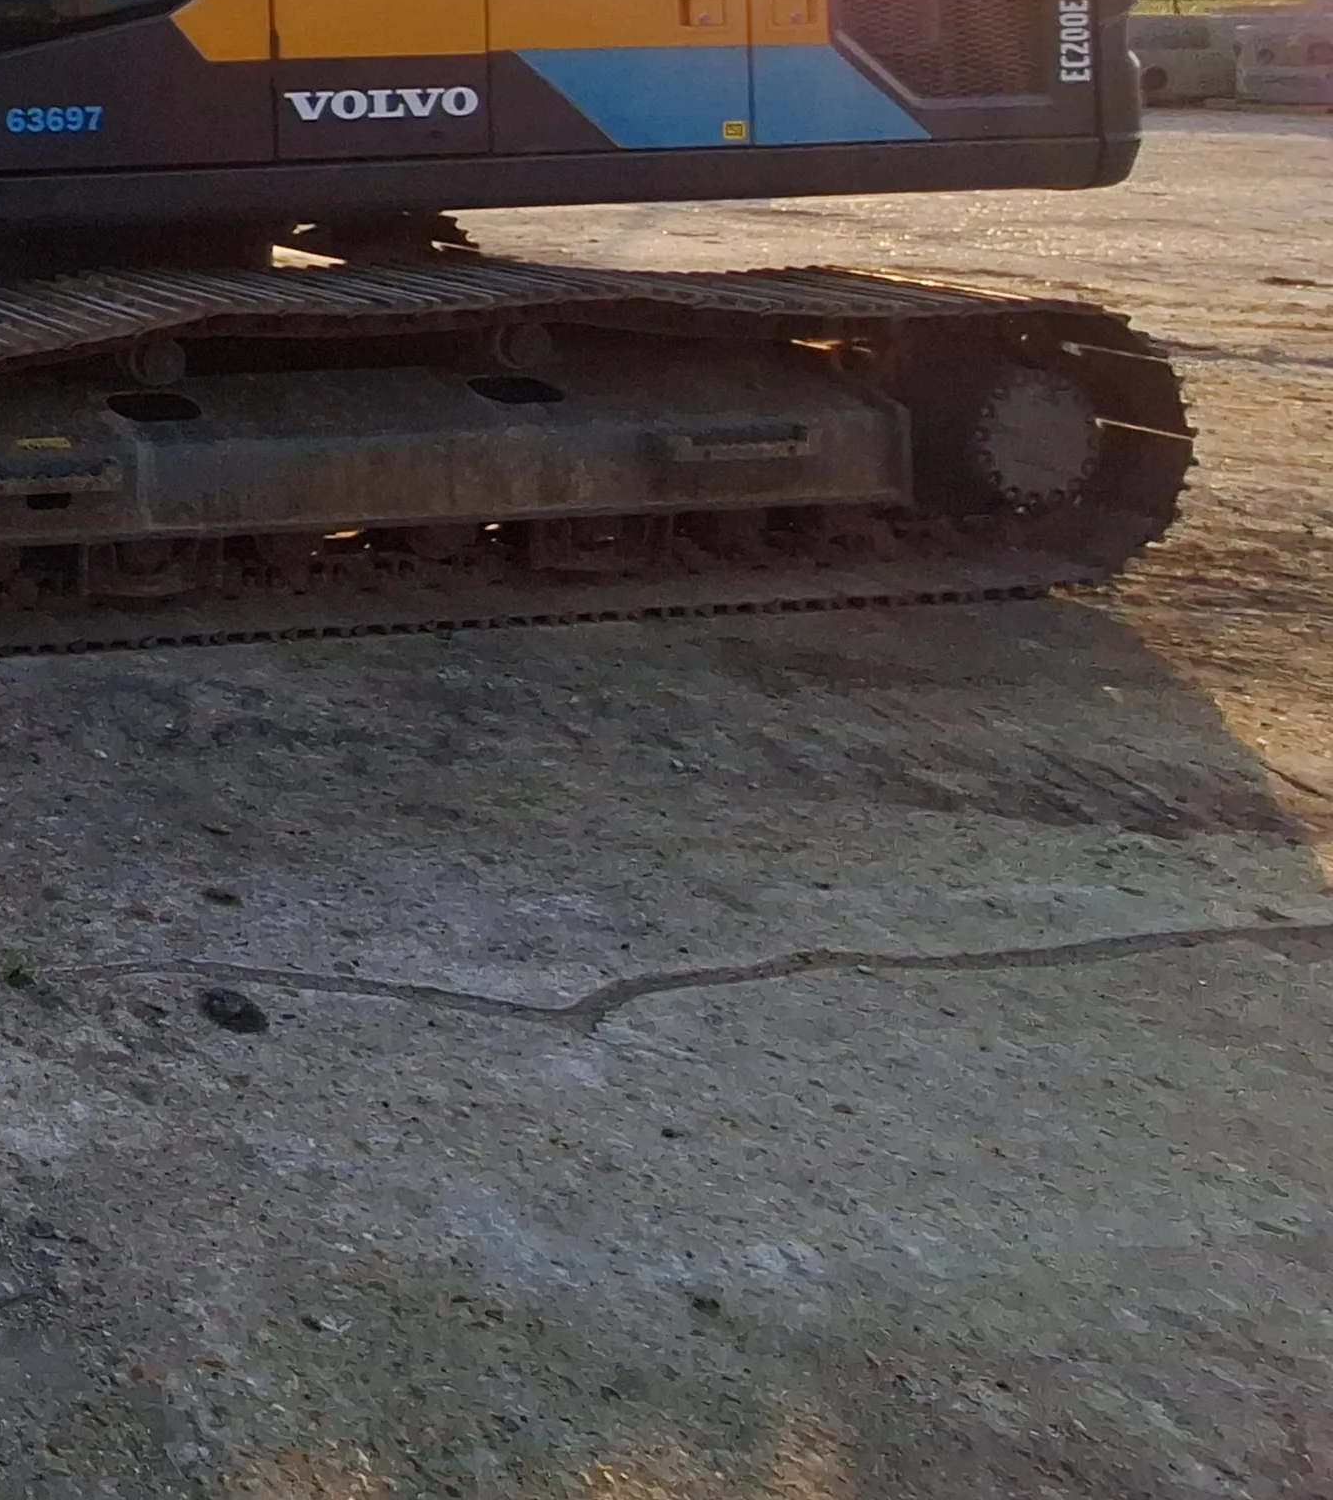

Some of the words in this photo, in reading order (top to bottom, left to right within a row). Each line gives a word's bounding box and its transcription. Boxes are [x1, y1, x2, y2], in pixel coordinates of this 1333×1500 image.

[1059, 0, 1090, 81] EC200E
[6, 105, 103, 133] 63697
[284, 87, 478, 121] VOLVO
